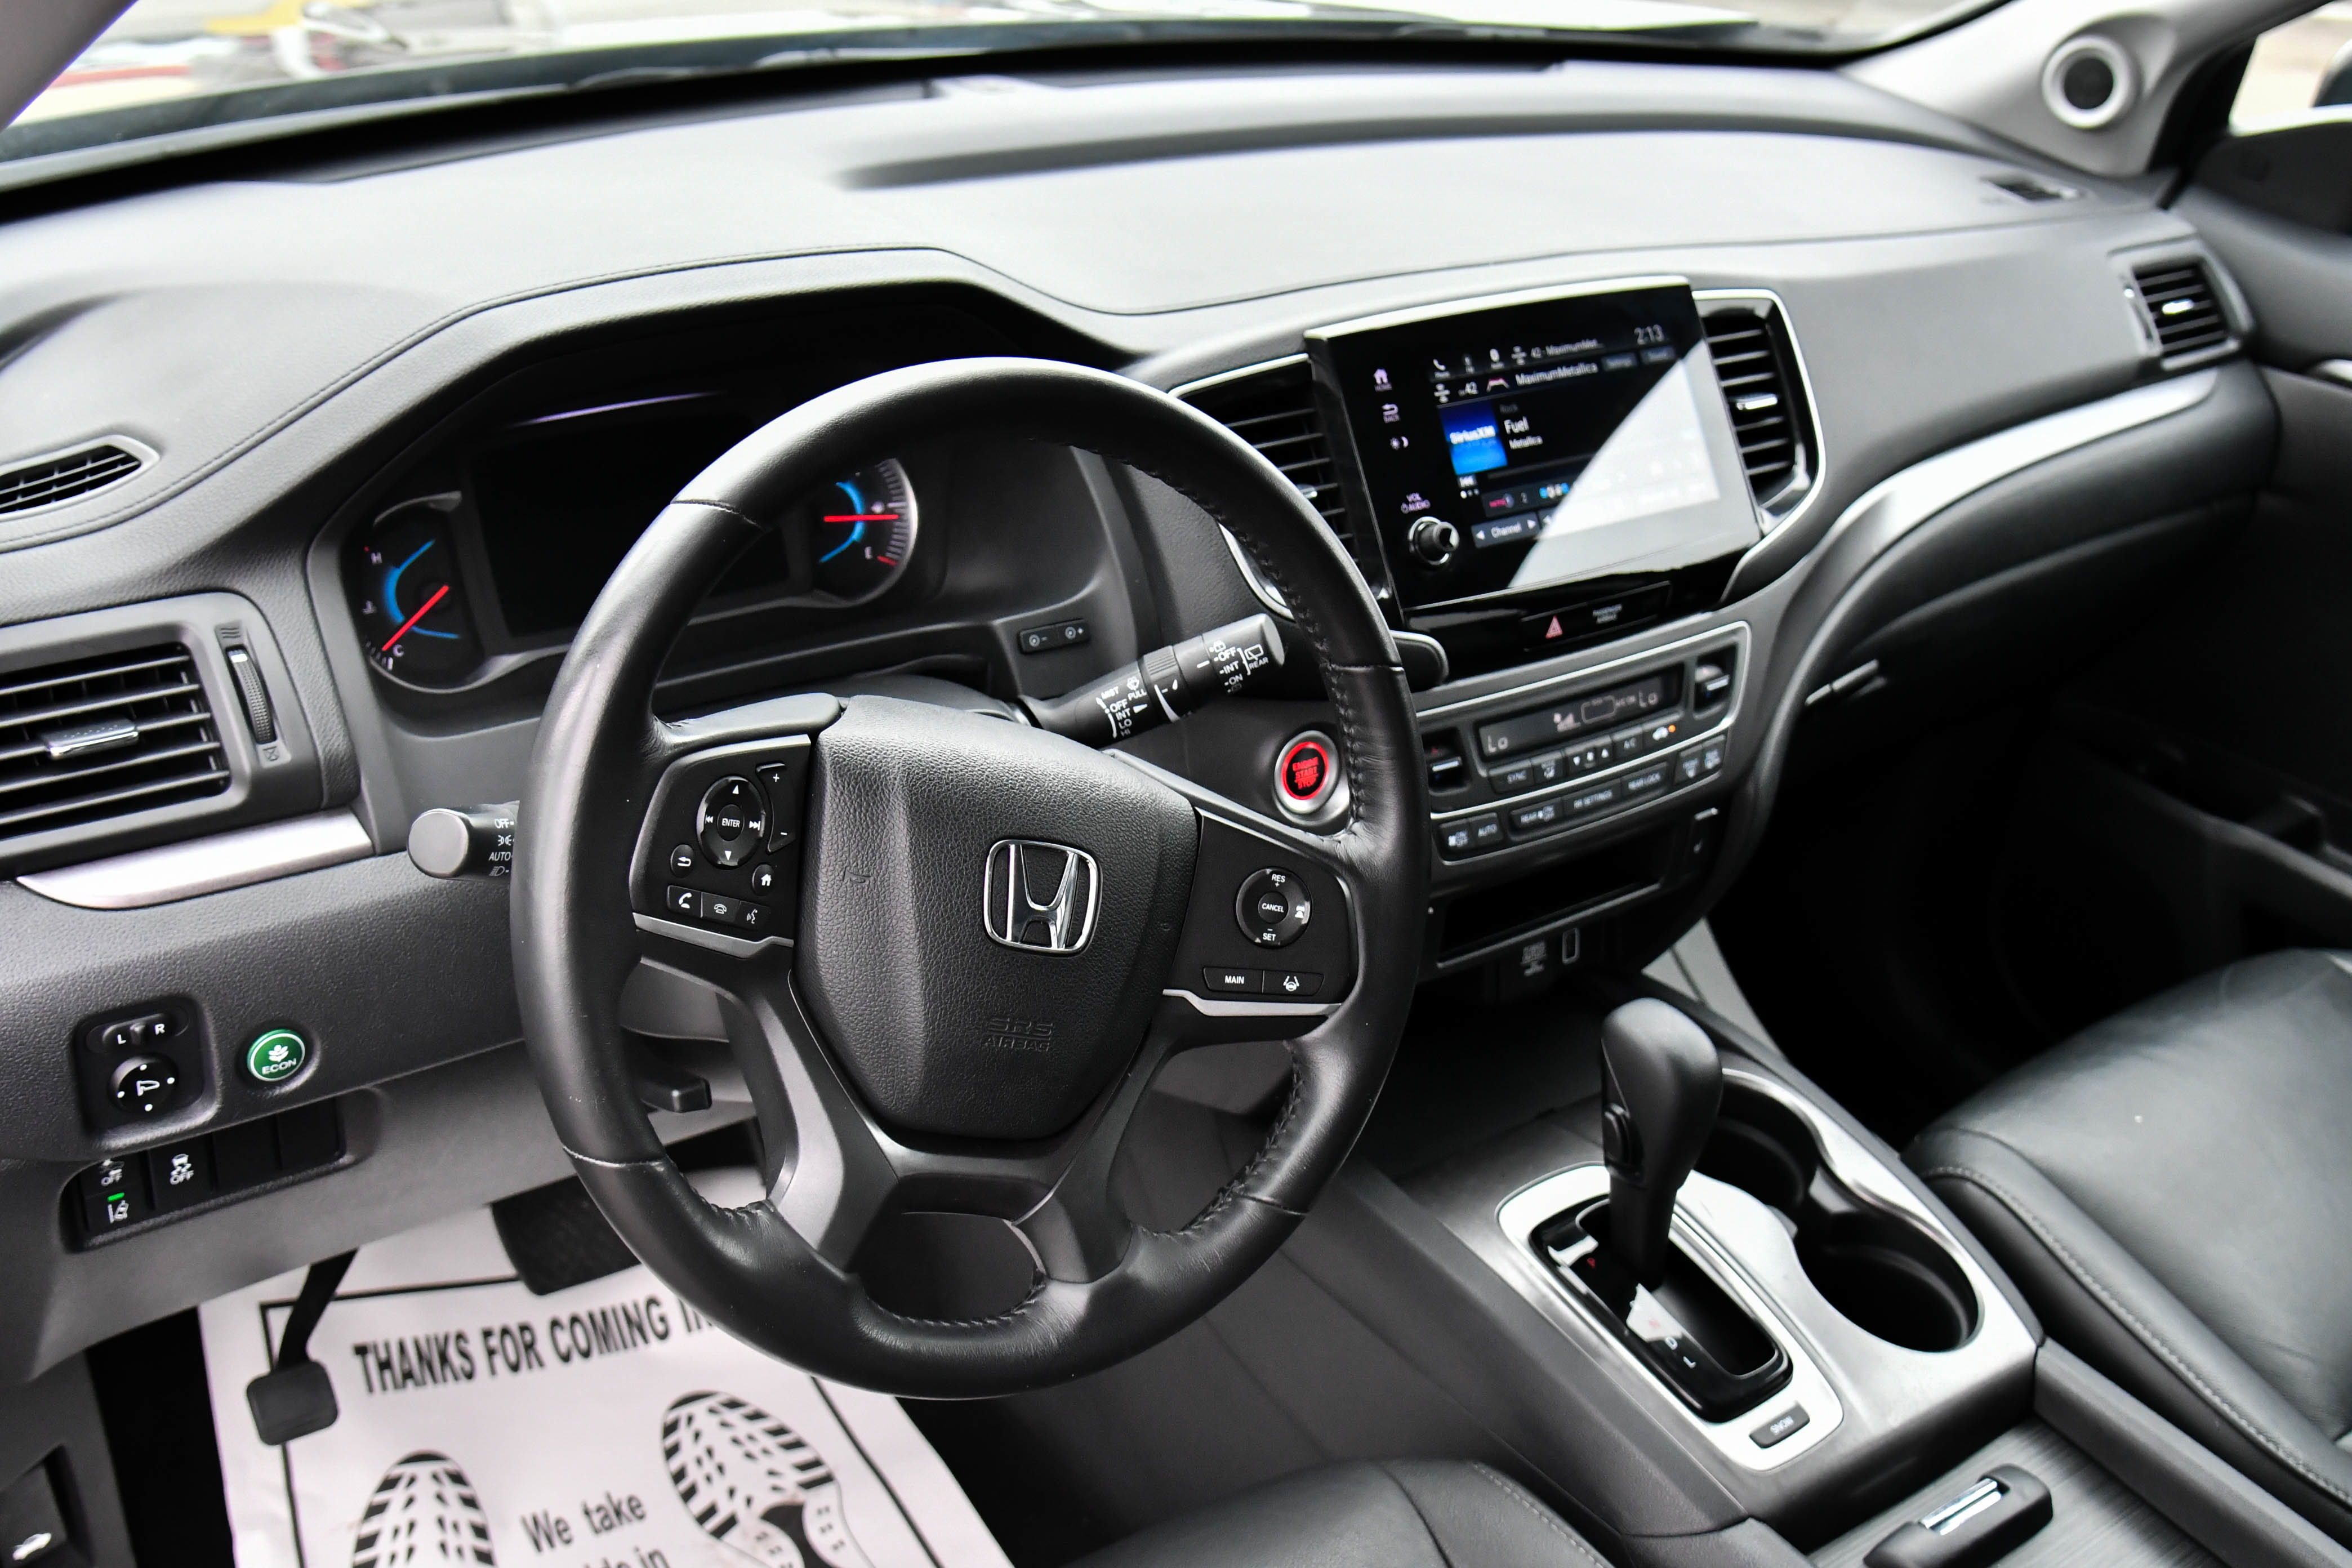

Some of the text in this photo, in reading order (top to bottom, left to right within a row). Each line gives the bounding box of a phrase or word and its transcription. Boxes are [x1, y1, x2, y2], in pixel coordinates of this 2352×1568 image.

[1634, 324, 1665, 346] 2:13
[1504, 416, 1530, 435] Fuel
[1218, 647, 1237, 661] OFF
[1223, 660, 1239, 674] INT
[1249, 657, 1269, 670] REAR
[1228, 673, 1244, 685] ON
[1127, 688, 1147, 701] PULL
[1109, 698, 1128, 713] OFF
[1115, 707, 1131, 721] INT
[1118, 718, 1133, 730] LO
[494, 818, 510, 828] OFF
[721, 818, 741, 828] ENTER
[488, 852, 511, 861] AUTO
[1271, 874, 1286, 883] RES
[1262, 903, 1284, 913] CANCEL
[1263, 933, 1277, 942] SET
[1224, 975, 1245, 985] MAIN
[154, 1023, 165, 1035] R
[117, 1034, 127, 1045] L
[261, 1057, 297, 1076] ECON
[101, 1170, 123, 1186] OFF
[170, 1170, 194, 1186] OFF
[353, 1330, 476, 1394] THANKS
[480, 1321, 545, 1376] FOR
[549, 1295, 670, 1363] COMING
[520, 1490, 647, 1553] We take
